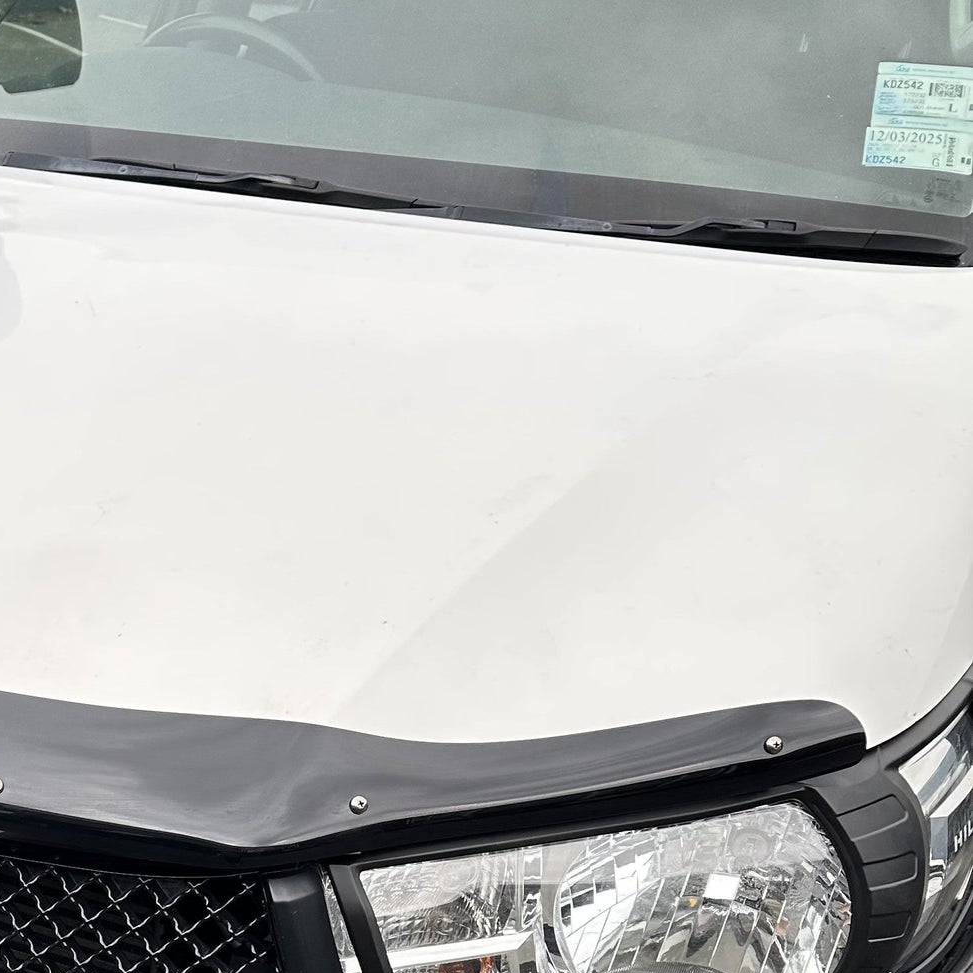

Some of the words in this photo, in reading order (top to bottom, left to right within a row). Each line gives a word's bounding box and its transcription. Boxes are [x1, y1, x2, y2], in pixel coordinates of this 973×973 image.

[883, 80, 924, 90] KDZ542
[871, 130, 943, 145] 12/03/2025
[865, 154, 906, 165] KDZ542
